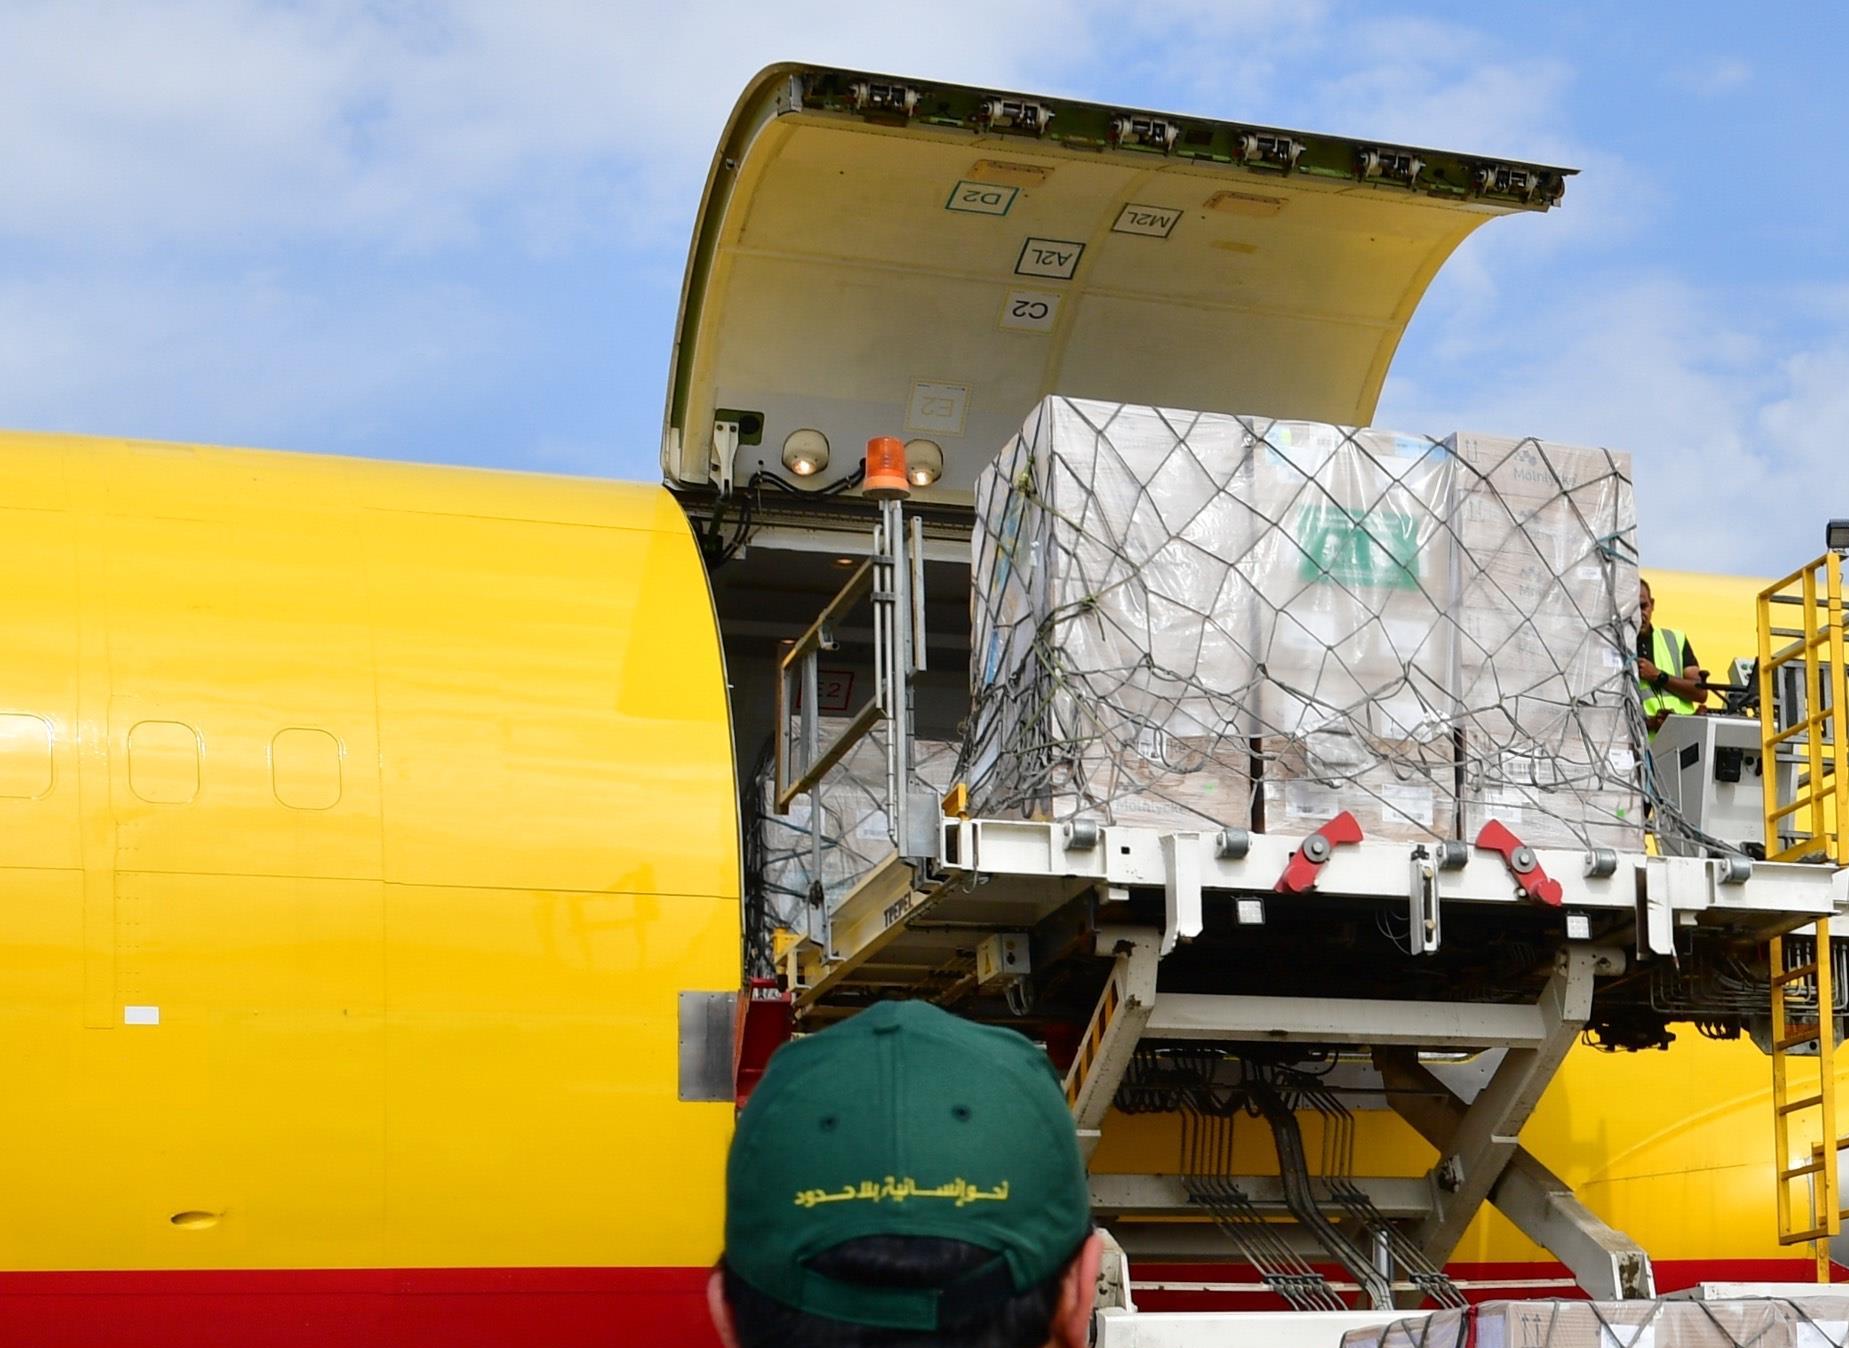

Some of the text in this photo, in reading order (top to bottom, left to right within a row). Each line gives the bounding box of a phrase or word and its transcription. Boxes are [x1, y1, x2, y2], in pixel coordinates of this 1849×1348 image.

[963, 190, 1001, 206] D2
[1127, 211, 1171, 229] M2L
[1031, 248, 1073, 267] A2L
[1011, 299, 1049, 320] C2
